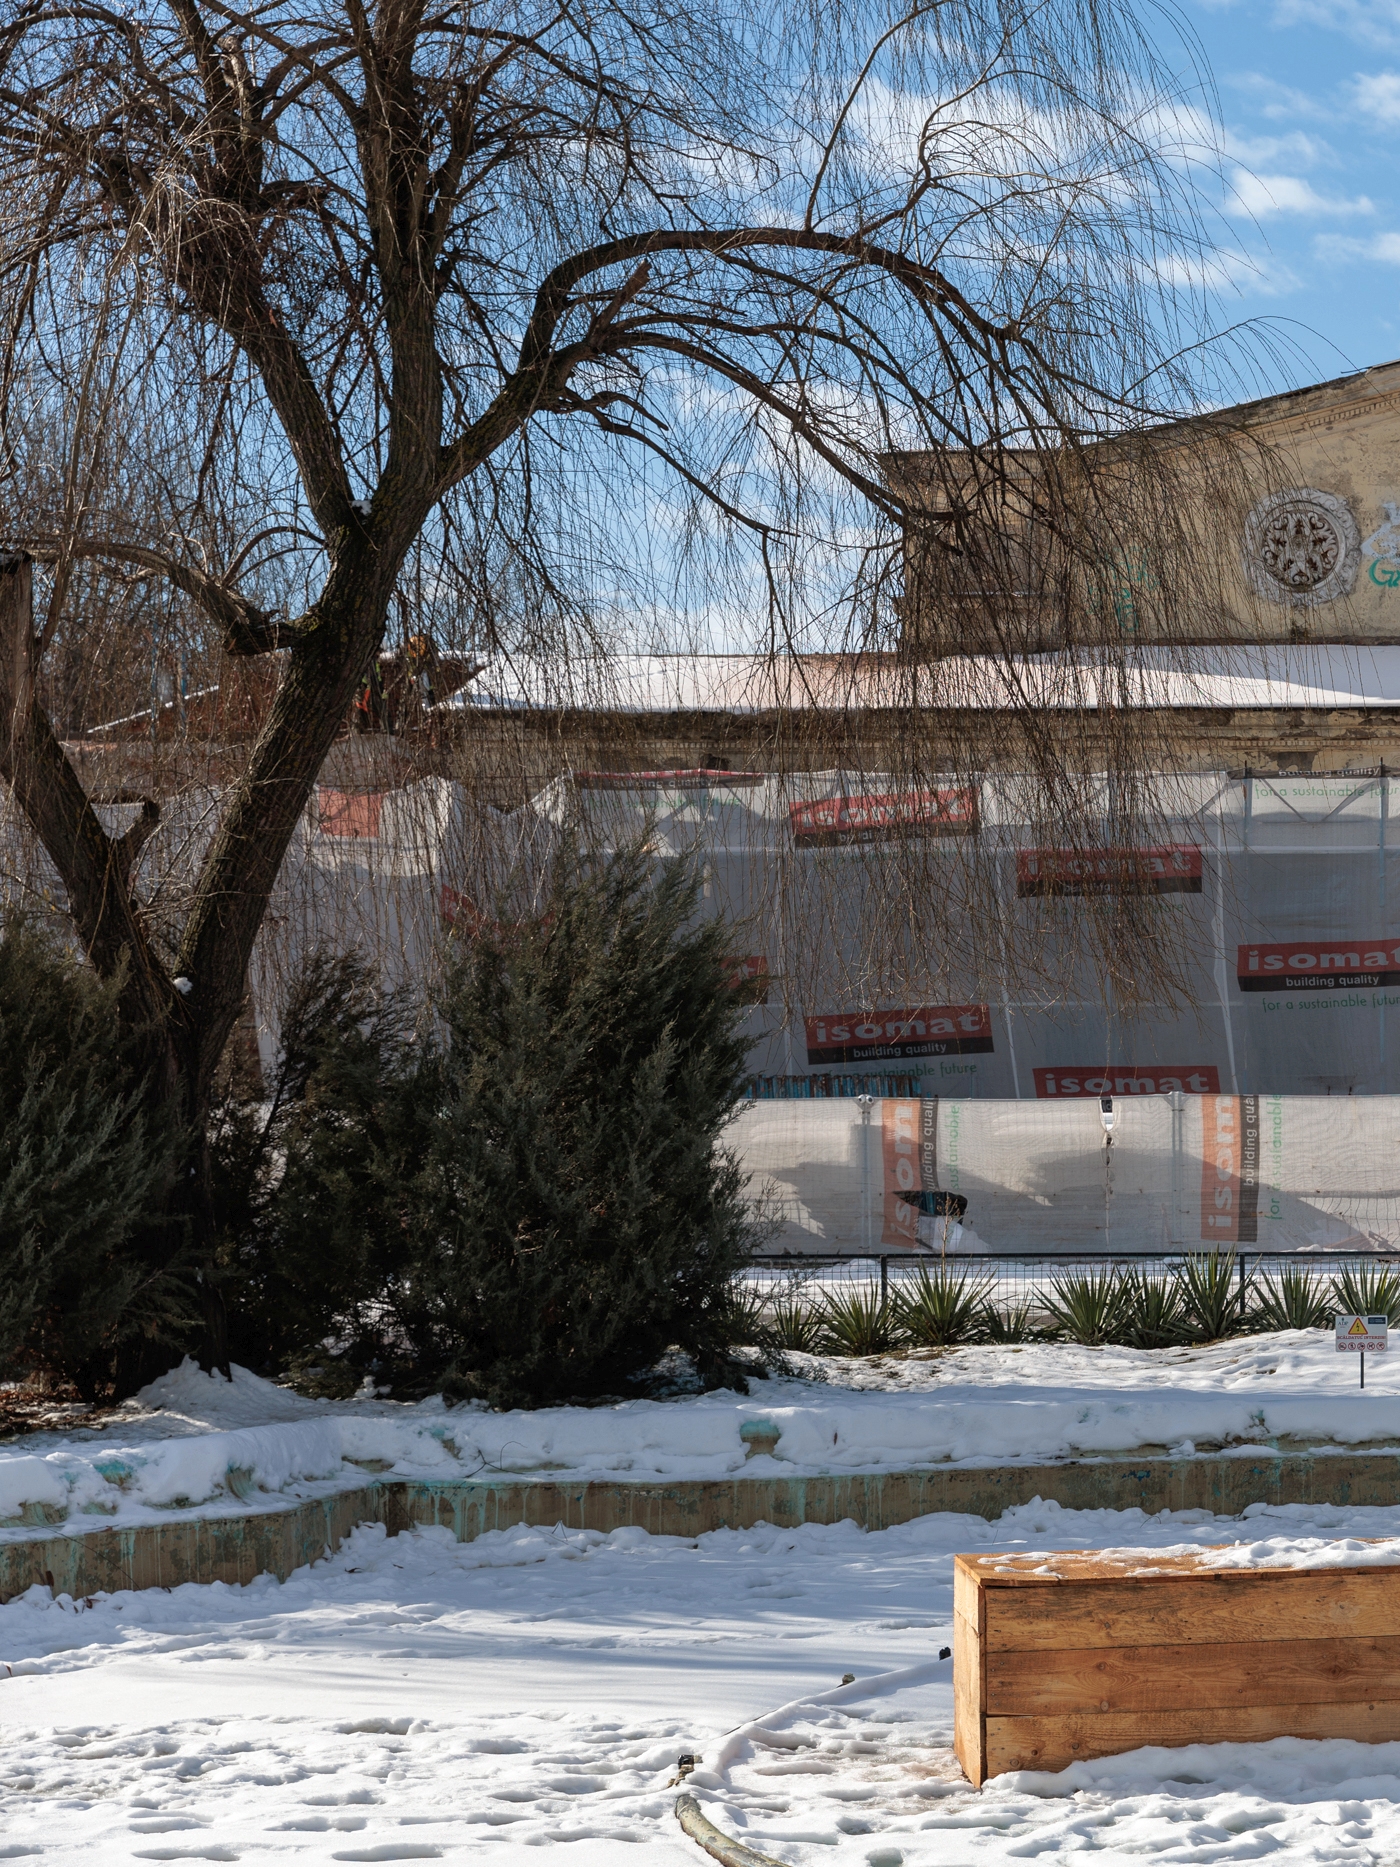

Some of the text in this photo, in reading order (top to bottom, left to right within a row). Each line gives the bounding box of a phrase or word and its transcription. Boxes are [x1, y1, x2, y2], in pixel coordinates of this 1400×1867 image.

[1255, 784, 1274, 798] for
[1279, 788, 1287, 796] a
[1293, 785, 1364, 797] sustainable
[1286, 975, 1379, 988] building quality
[1262, 997, 1280, 1013] for
[1285, 1001, 1294, 1010] a
[1298, 994, 1367, 1010] sustainable
[816, 1012, 980, 1042] isomat
[853, 1042, 947, 1058] building quality
[940, 1061, 977, 1078] future
[1045, 1073, 1209, 1094] isomat
[1208, 1096, 1234, 1228] isom
[1244, 1129, 1257, 1186] building
[1264, 1198, 1282, 1220] for
